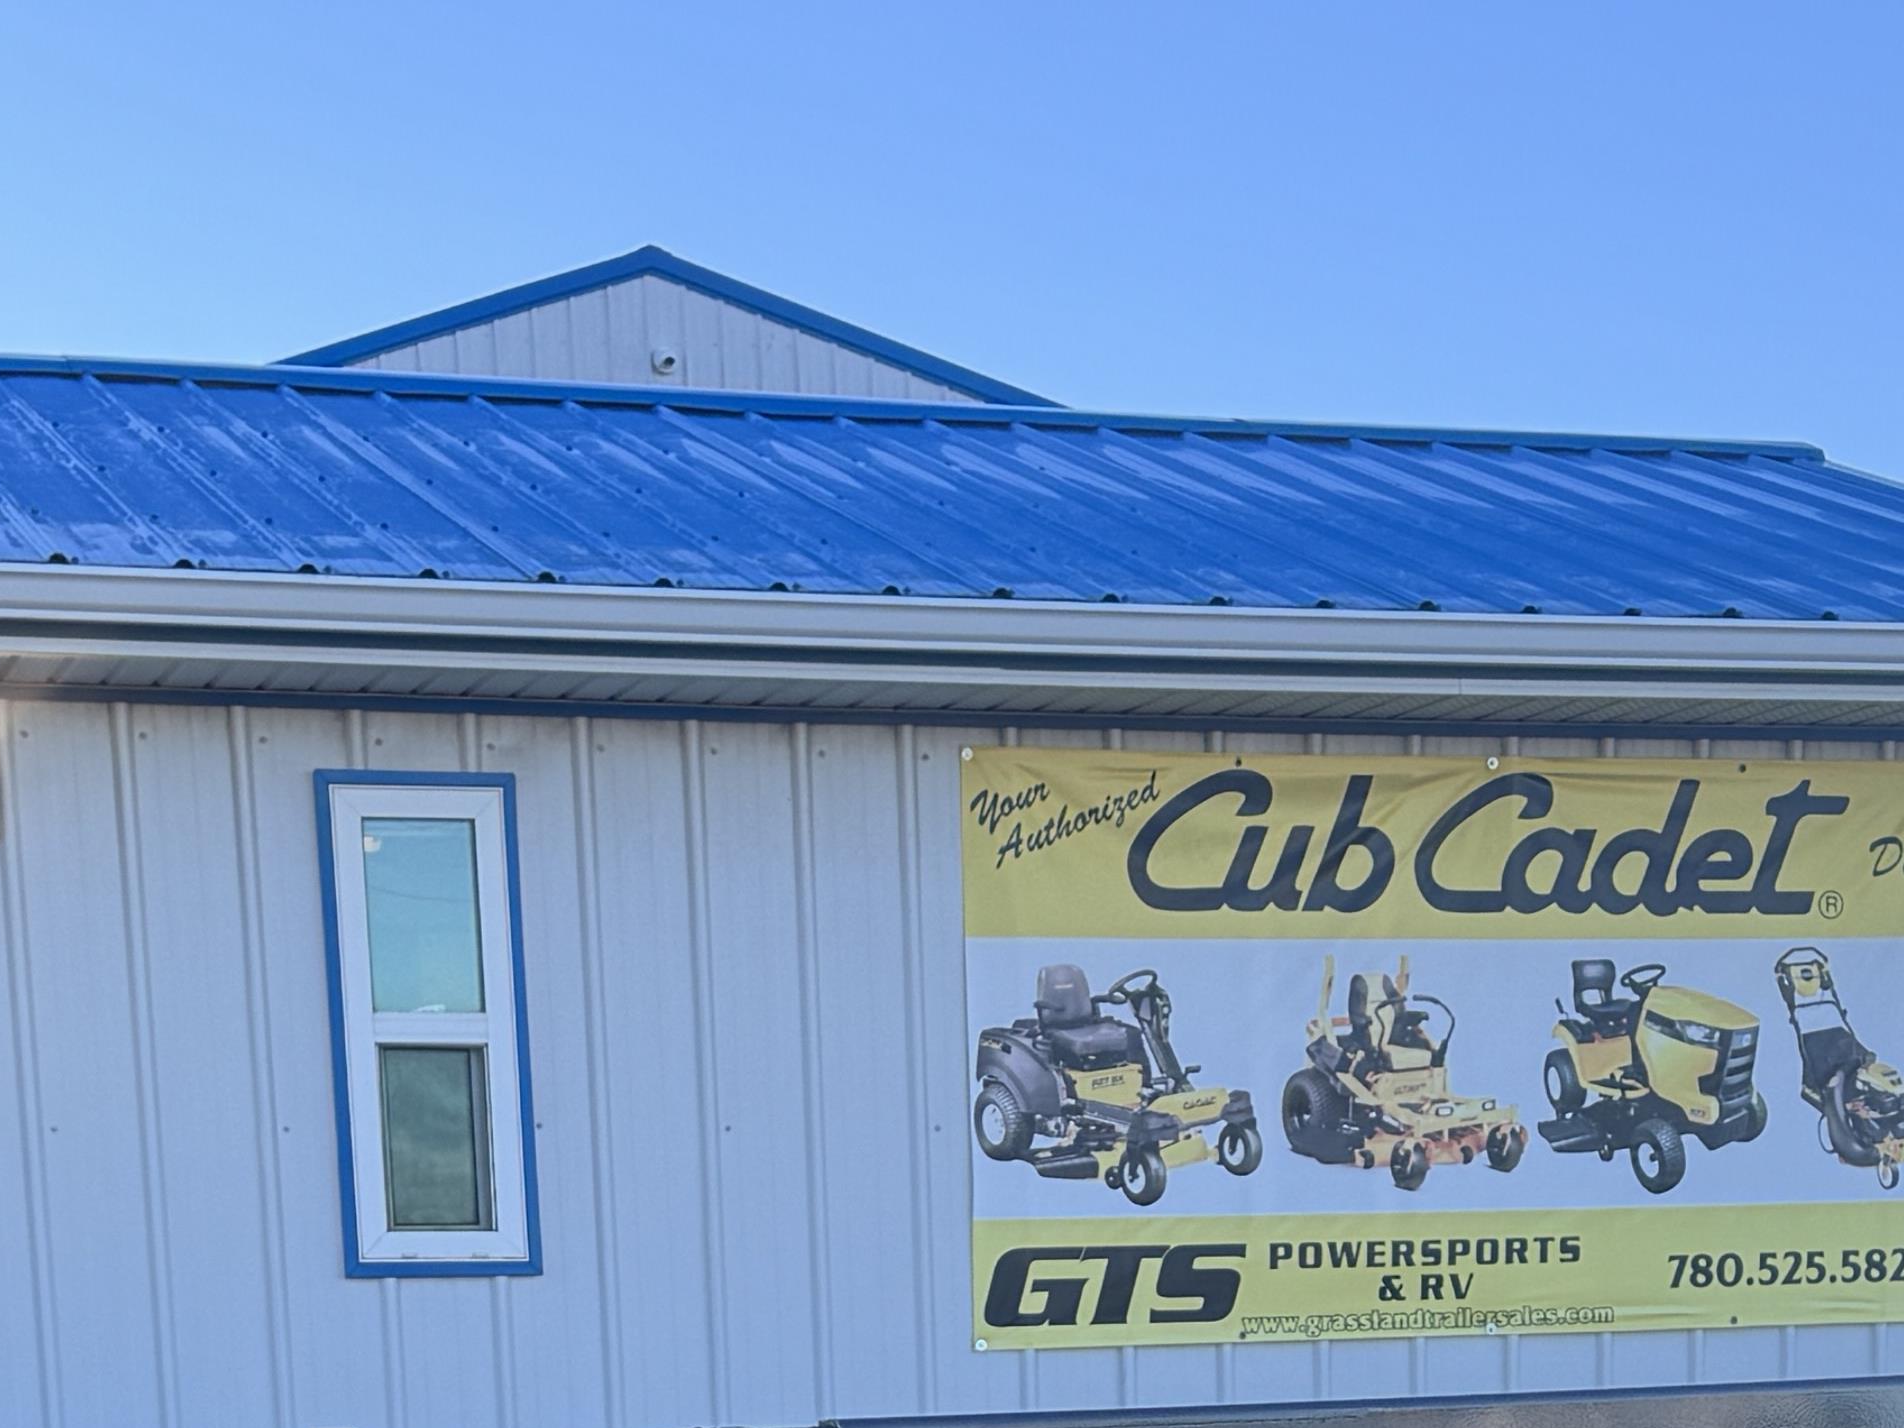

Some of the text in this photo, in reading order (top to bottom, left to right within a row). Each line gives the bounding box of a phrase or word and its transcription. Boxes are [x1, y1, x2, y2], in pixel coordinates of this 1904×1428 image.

[970, 781, 1051, 835] Your
[996, 769, 1161, 869] Authorized
[1127, 768, 1396, 913] Cub
[1414, 772, 1851, 918] Cadet
[1269, 1236, 1582, 1270] POWERSPORTS
[983, 1243, 1247, 1328] GTS
[1378, 1272, 1475, 1301] & RV
[1241, 1305, 1615, 1337] www.grasslandtrailersales.com
